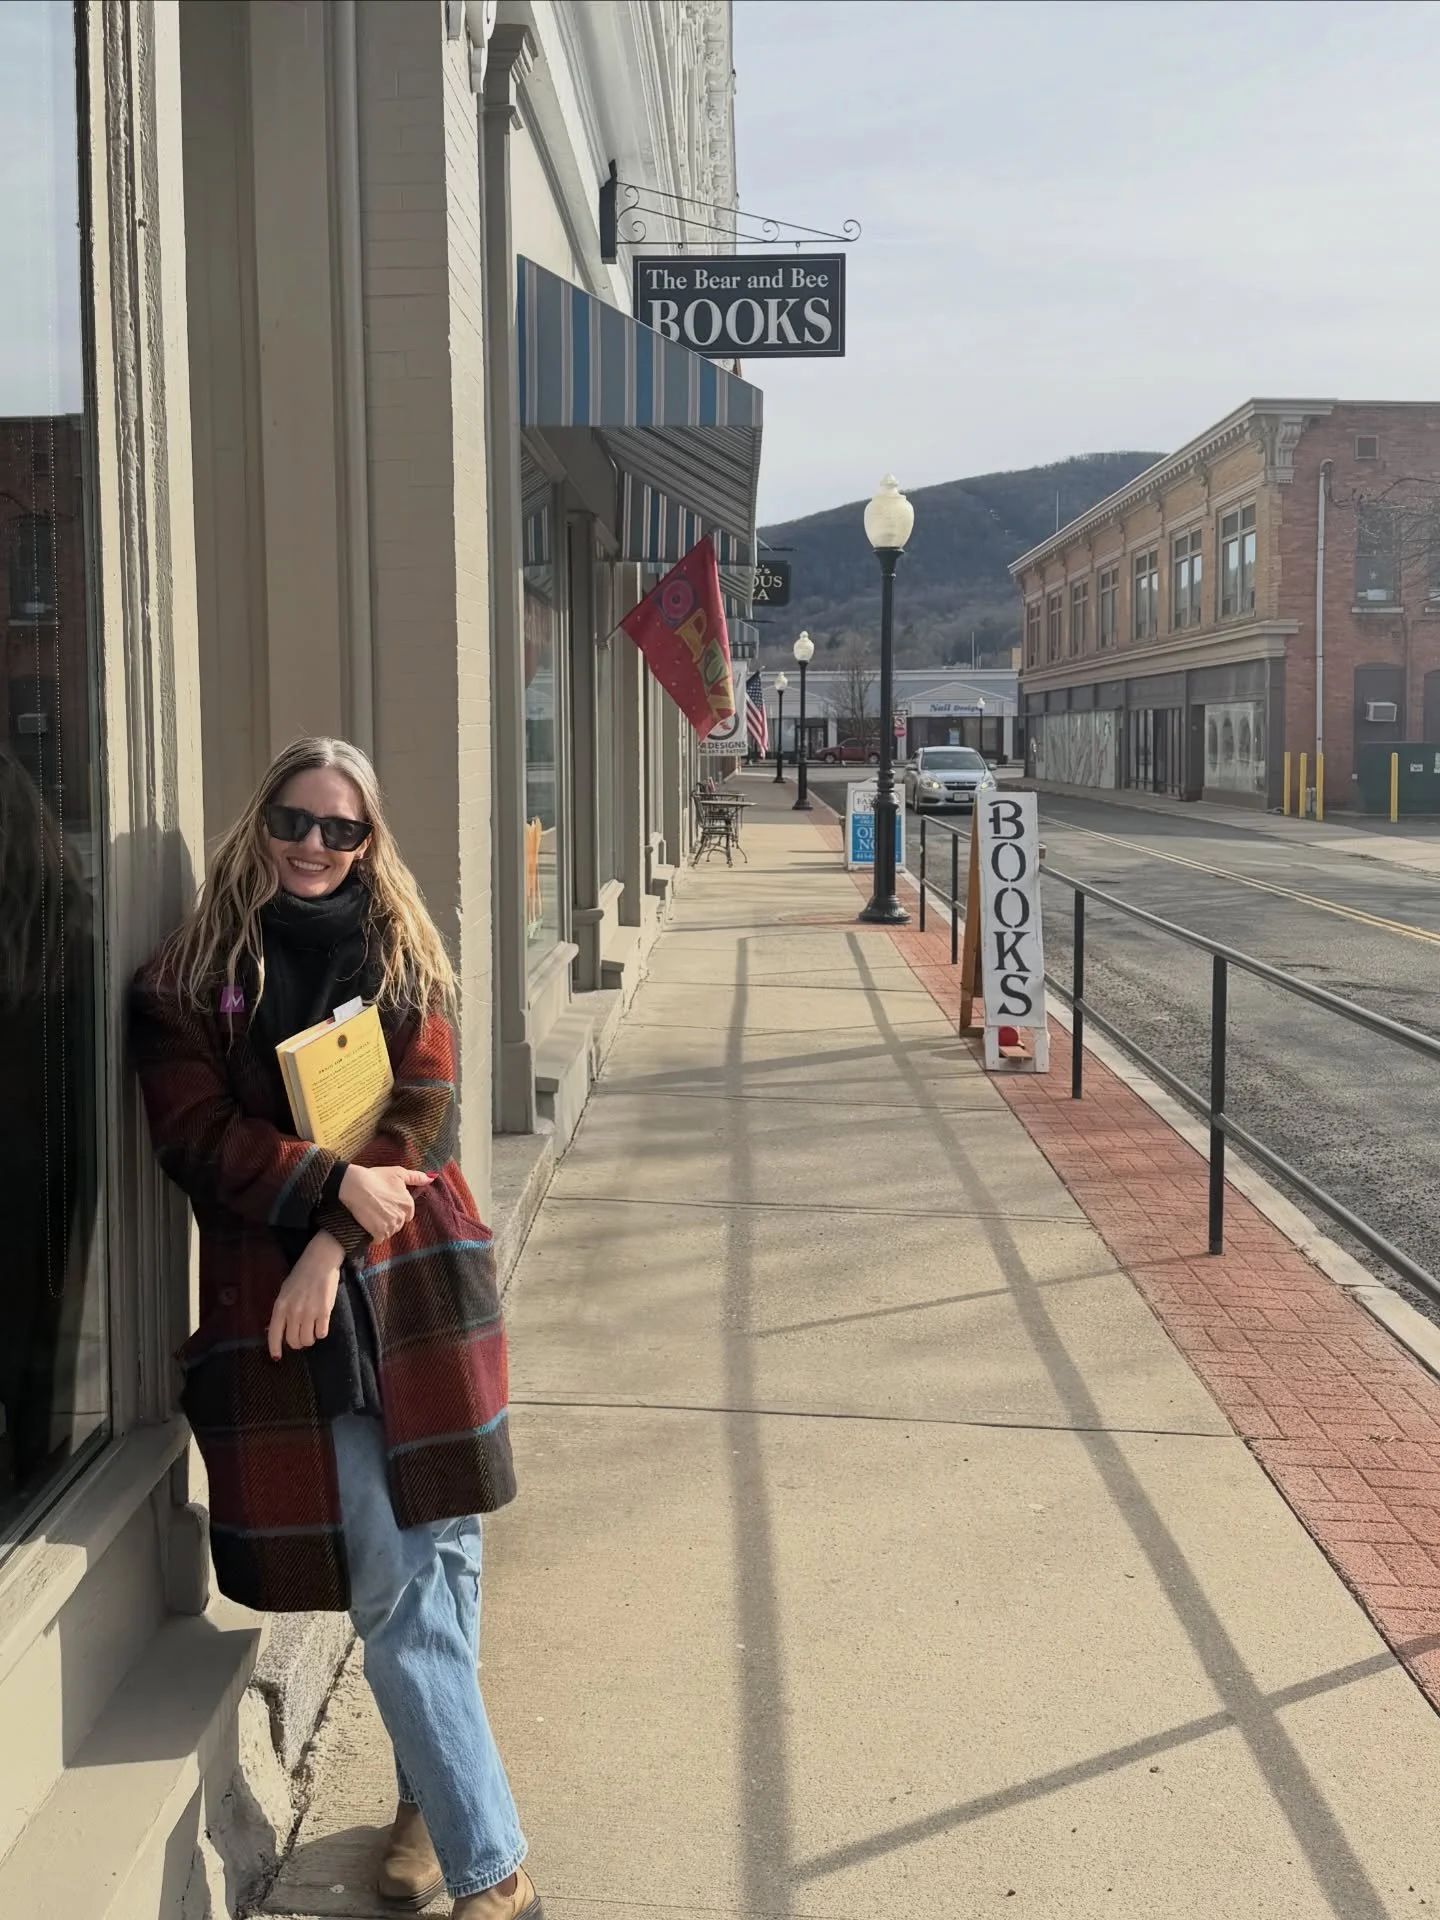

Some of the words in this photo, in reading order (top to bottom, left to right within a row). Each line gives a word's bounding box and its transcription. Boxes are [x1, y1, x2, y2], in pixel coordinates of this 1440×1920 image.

[646, 269, 688, 290] The
[694, 268, 741, 289] Bear
[747, 268, 784, 288] and
[791, 267, 829, 288] Bee
[647, 297, 832, 345] BOOKS
[707, 741, 746, 749] DESIGNS
[987, 799, 1032, 1017] BOOKS
